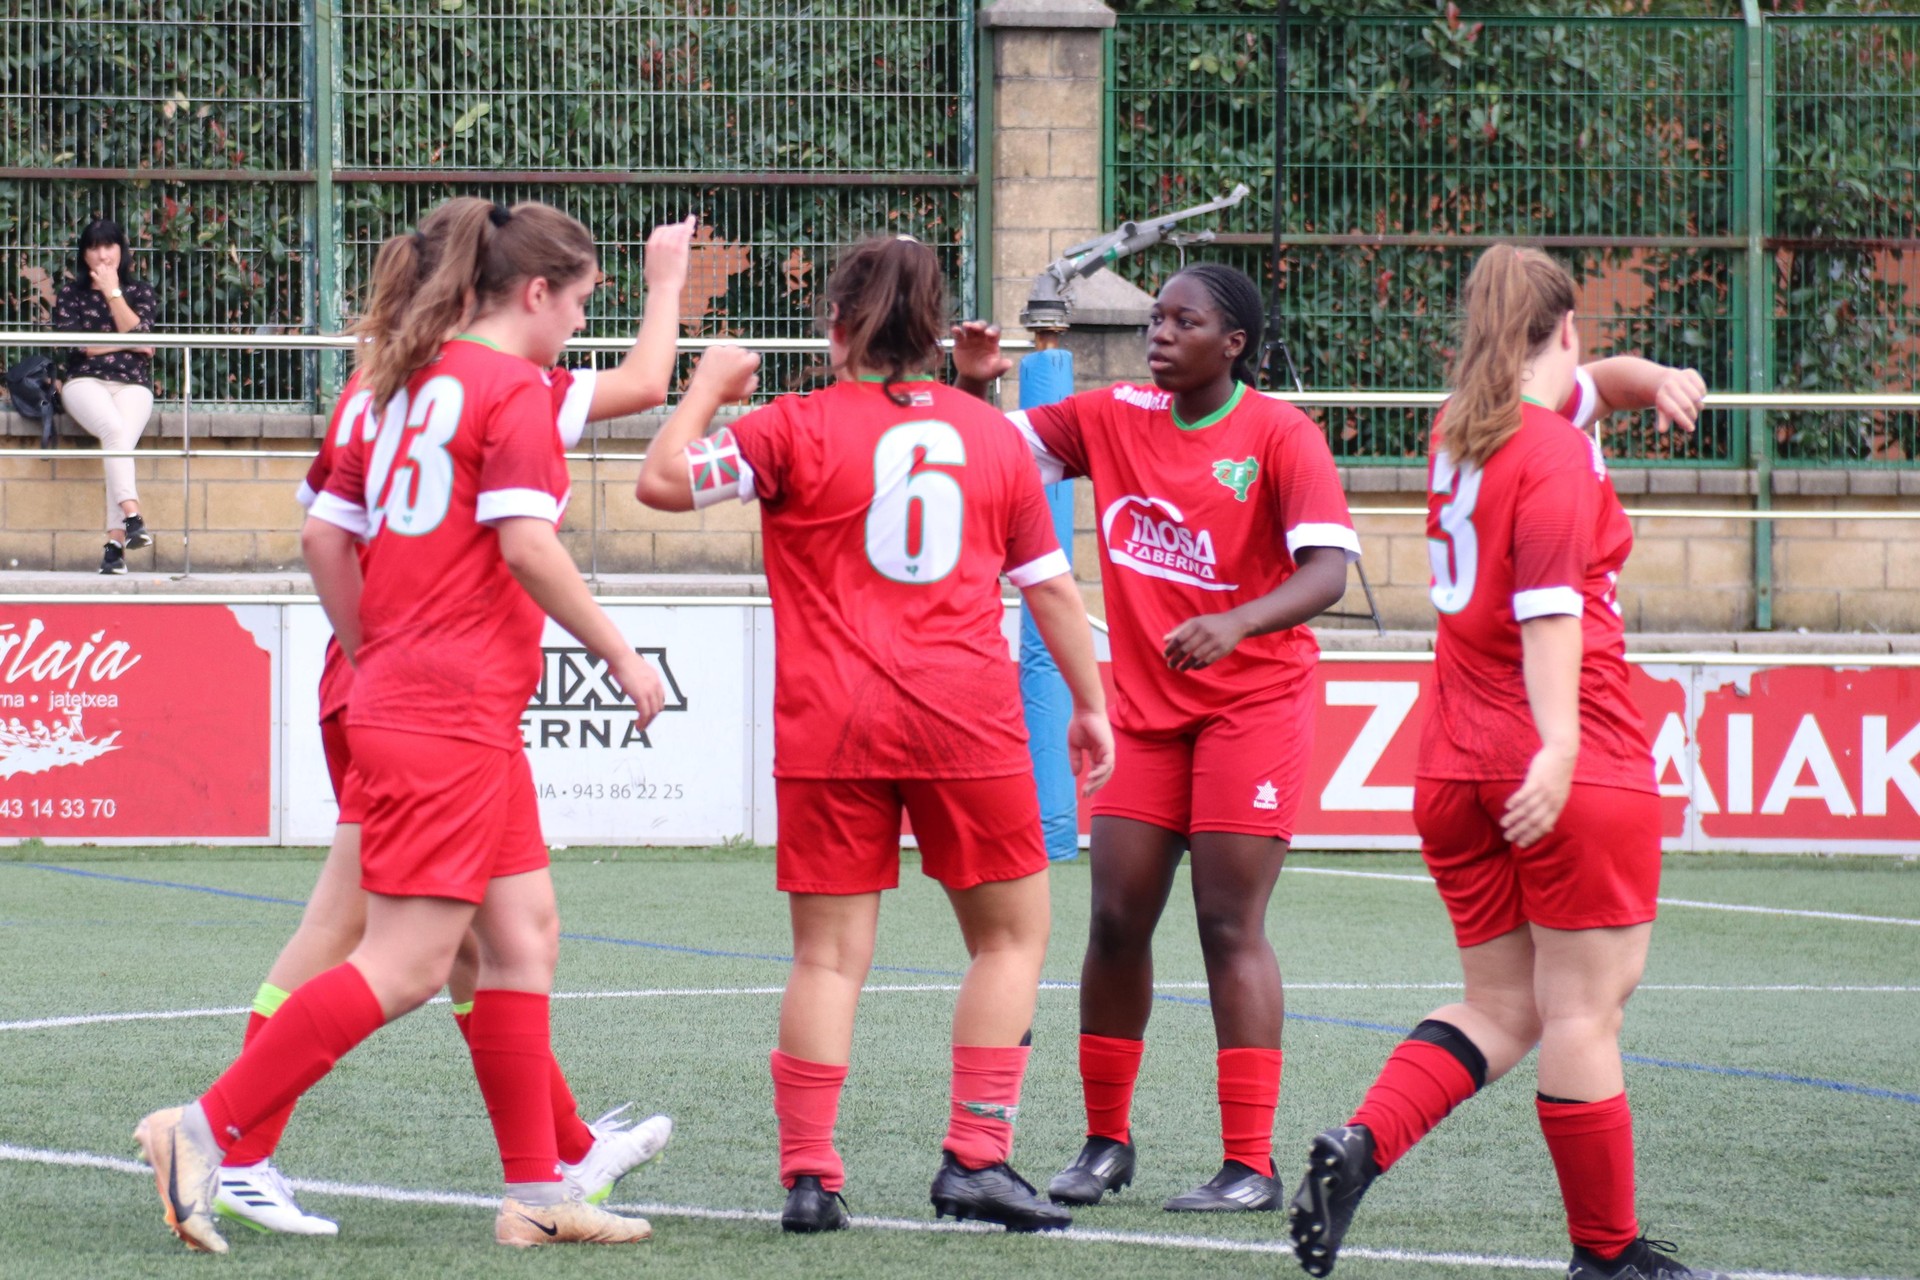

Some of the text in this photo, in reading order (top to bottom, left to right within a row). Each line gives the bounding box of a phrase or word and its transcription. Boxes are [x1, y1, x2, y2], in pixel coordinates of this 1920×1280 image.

[864, 419, 966, 586] 6
[1129, 508, 1216, 565] TAOSA
[1427, 450, 1484, 614] 3
[1123, 539, 1216, 580] TABERNA
[48, 690, 119, 712] jatetxea
[31, 798, 53, 819] 14
[60, 798, 85, 819] 33
[91, 798, 116, 819] 70
[572, 783, 604, 800] 943
[610, 783, 632, 800] 86
[636, 783, 657, 800] 22
[663, 783, 684, 800] 25
